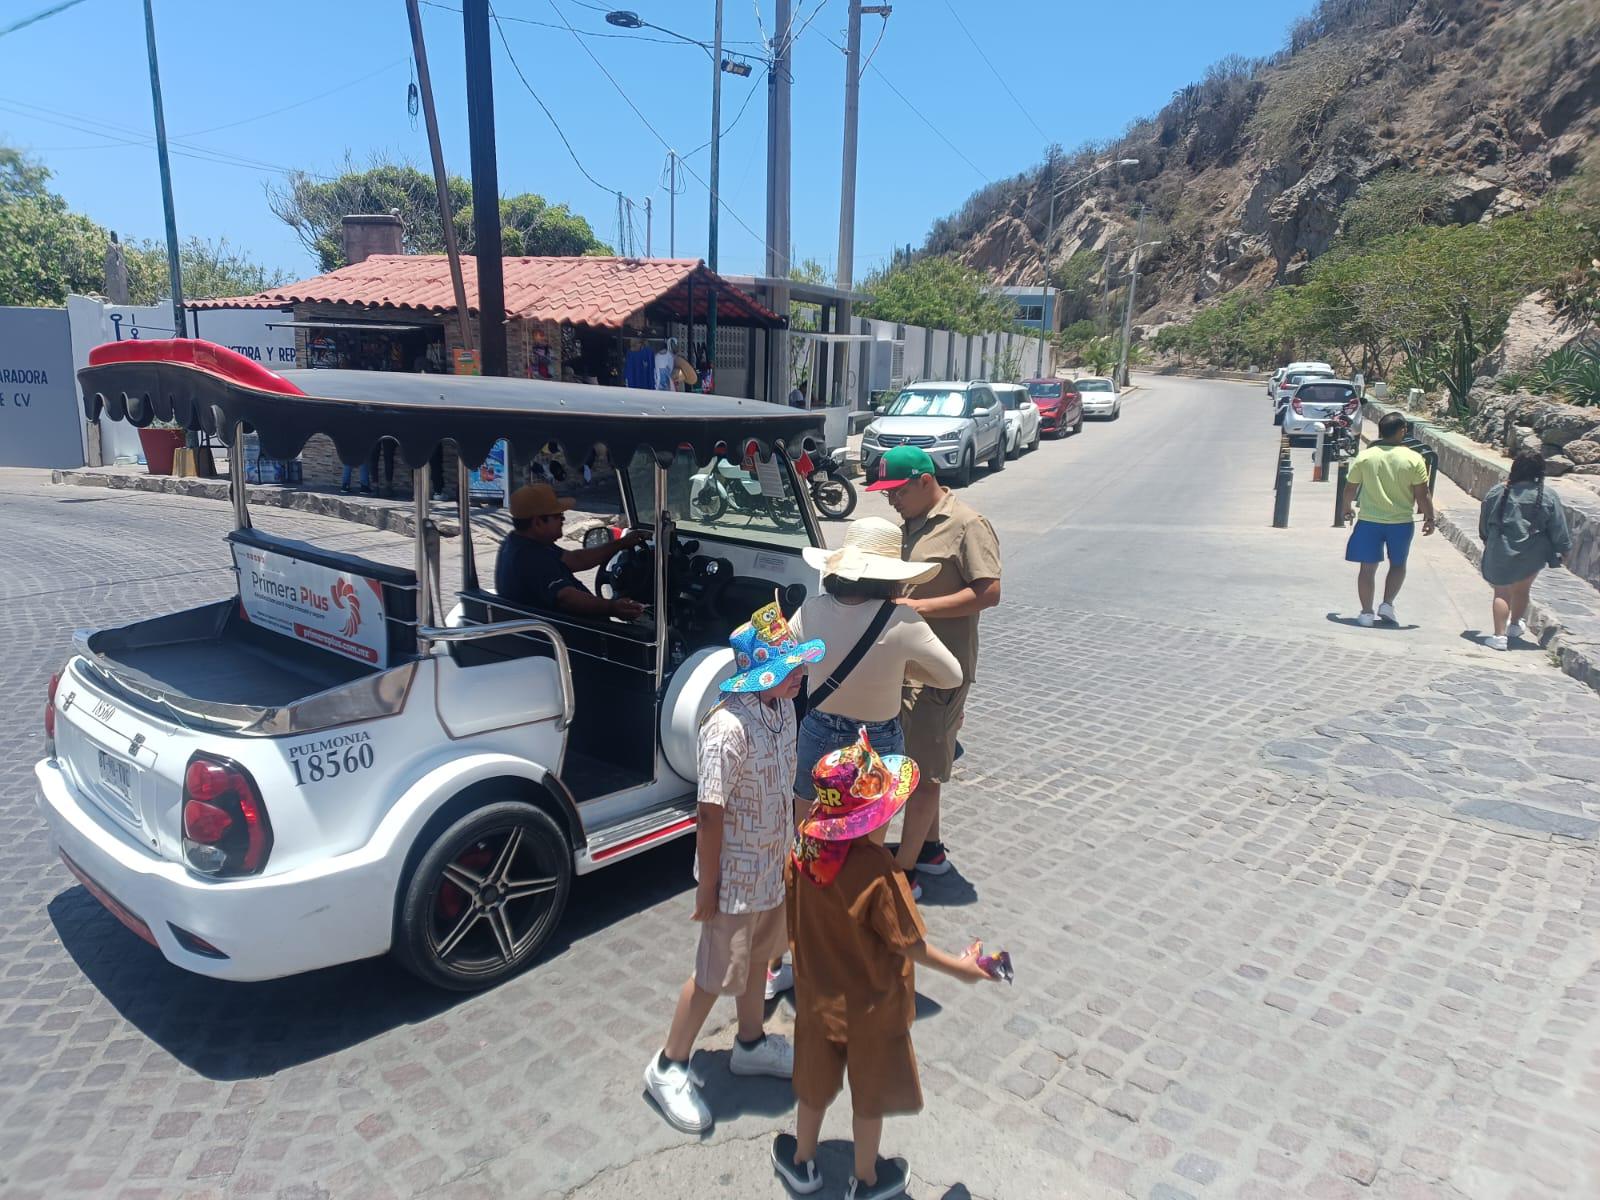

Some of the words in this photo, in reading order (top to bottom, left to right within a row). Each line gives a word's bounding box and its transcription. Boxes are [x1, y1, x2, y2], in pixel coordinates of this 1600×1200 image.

[266, 346, 274, 361] Y
[278, 347, 296, 362] REP
[14, 393, 31, 407] CV
[251, 571, 297, 602] Primera
[300, 586, 329, 612] Plus
[92, 699, 116, 722] 18560
[288, 731, 371, 758] PULMONIA
[290, 743, 374, 787] 18560
[816, 787, 843, 807] ER
